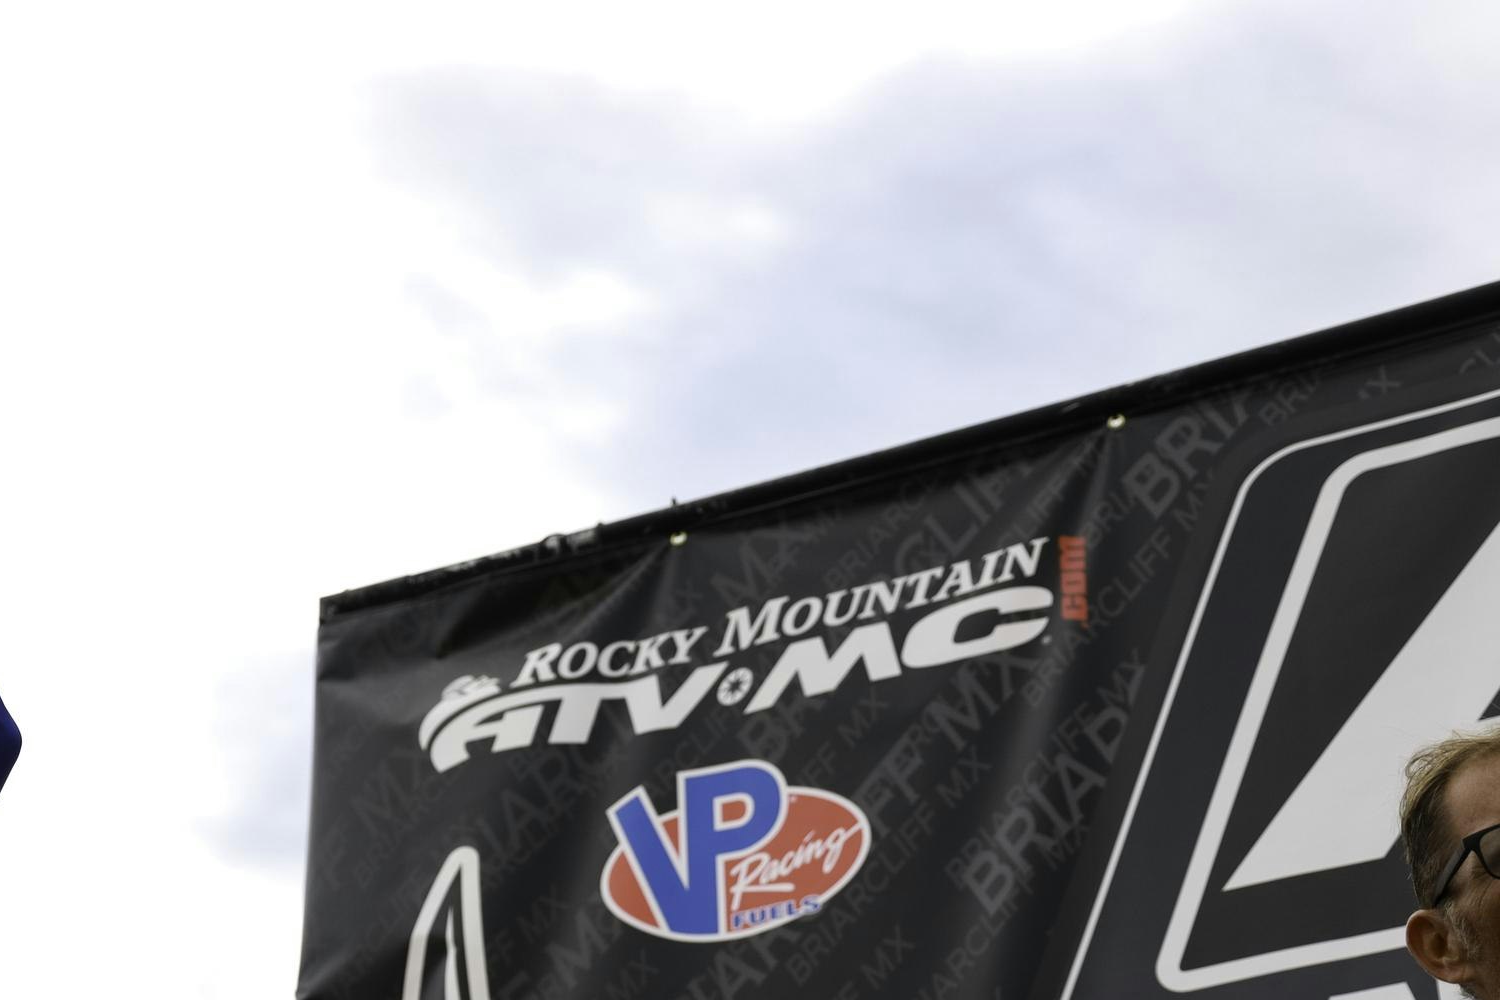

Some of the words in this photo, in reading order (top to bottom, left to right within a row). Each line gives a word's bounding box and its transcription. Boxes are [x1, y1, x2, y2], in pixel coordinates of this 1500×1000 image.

[509, 626, 709, 688] ROCKY
[606, 759, 788, 937] VP
[730, 821, 862, 910] Racing
[732, 896, 823, 930] FUELS
[859, 925, 916, 990] MX
